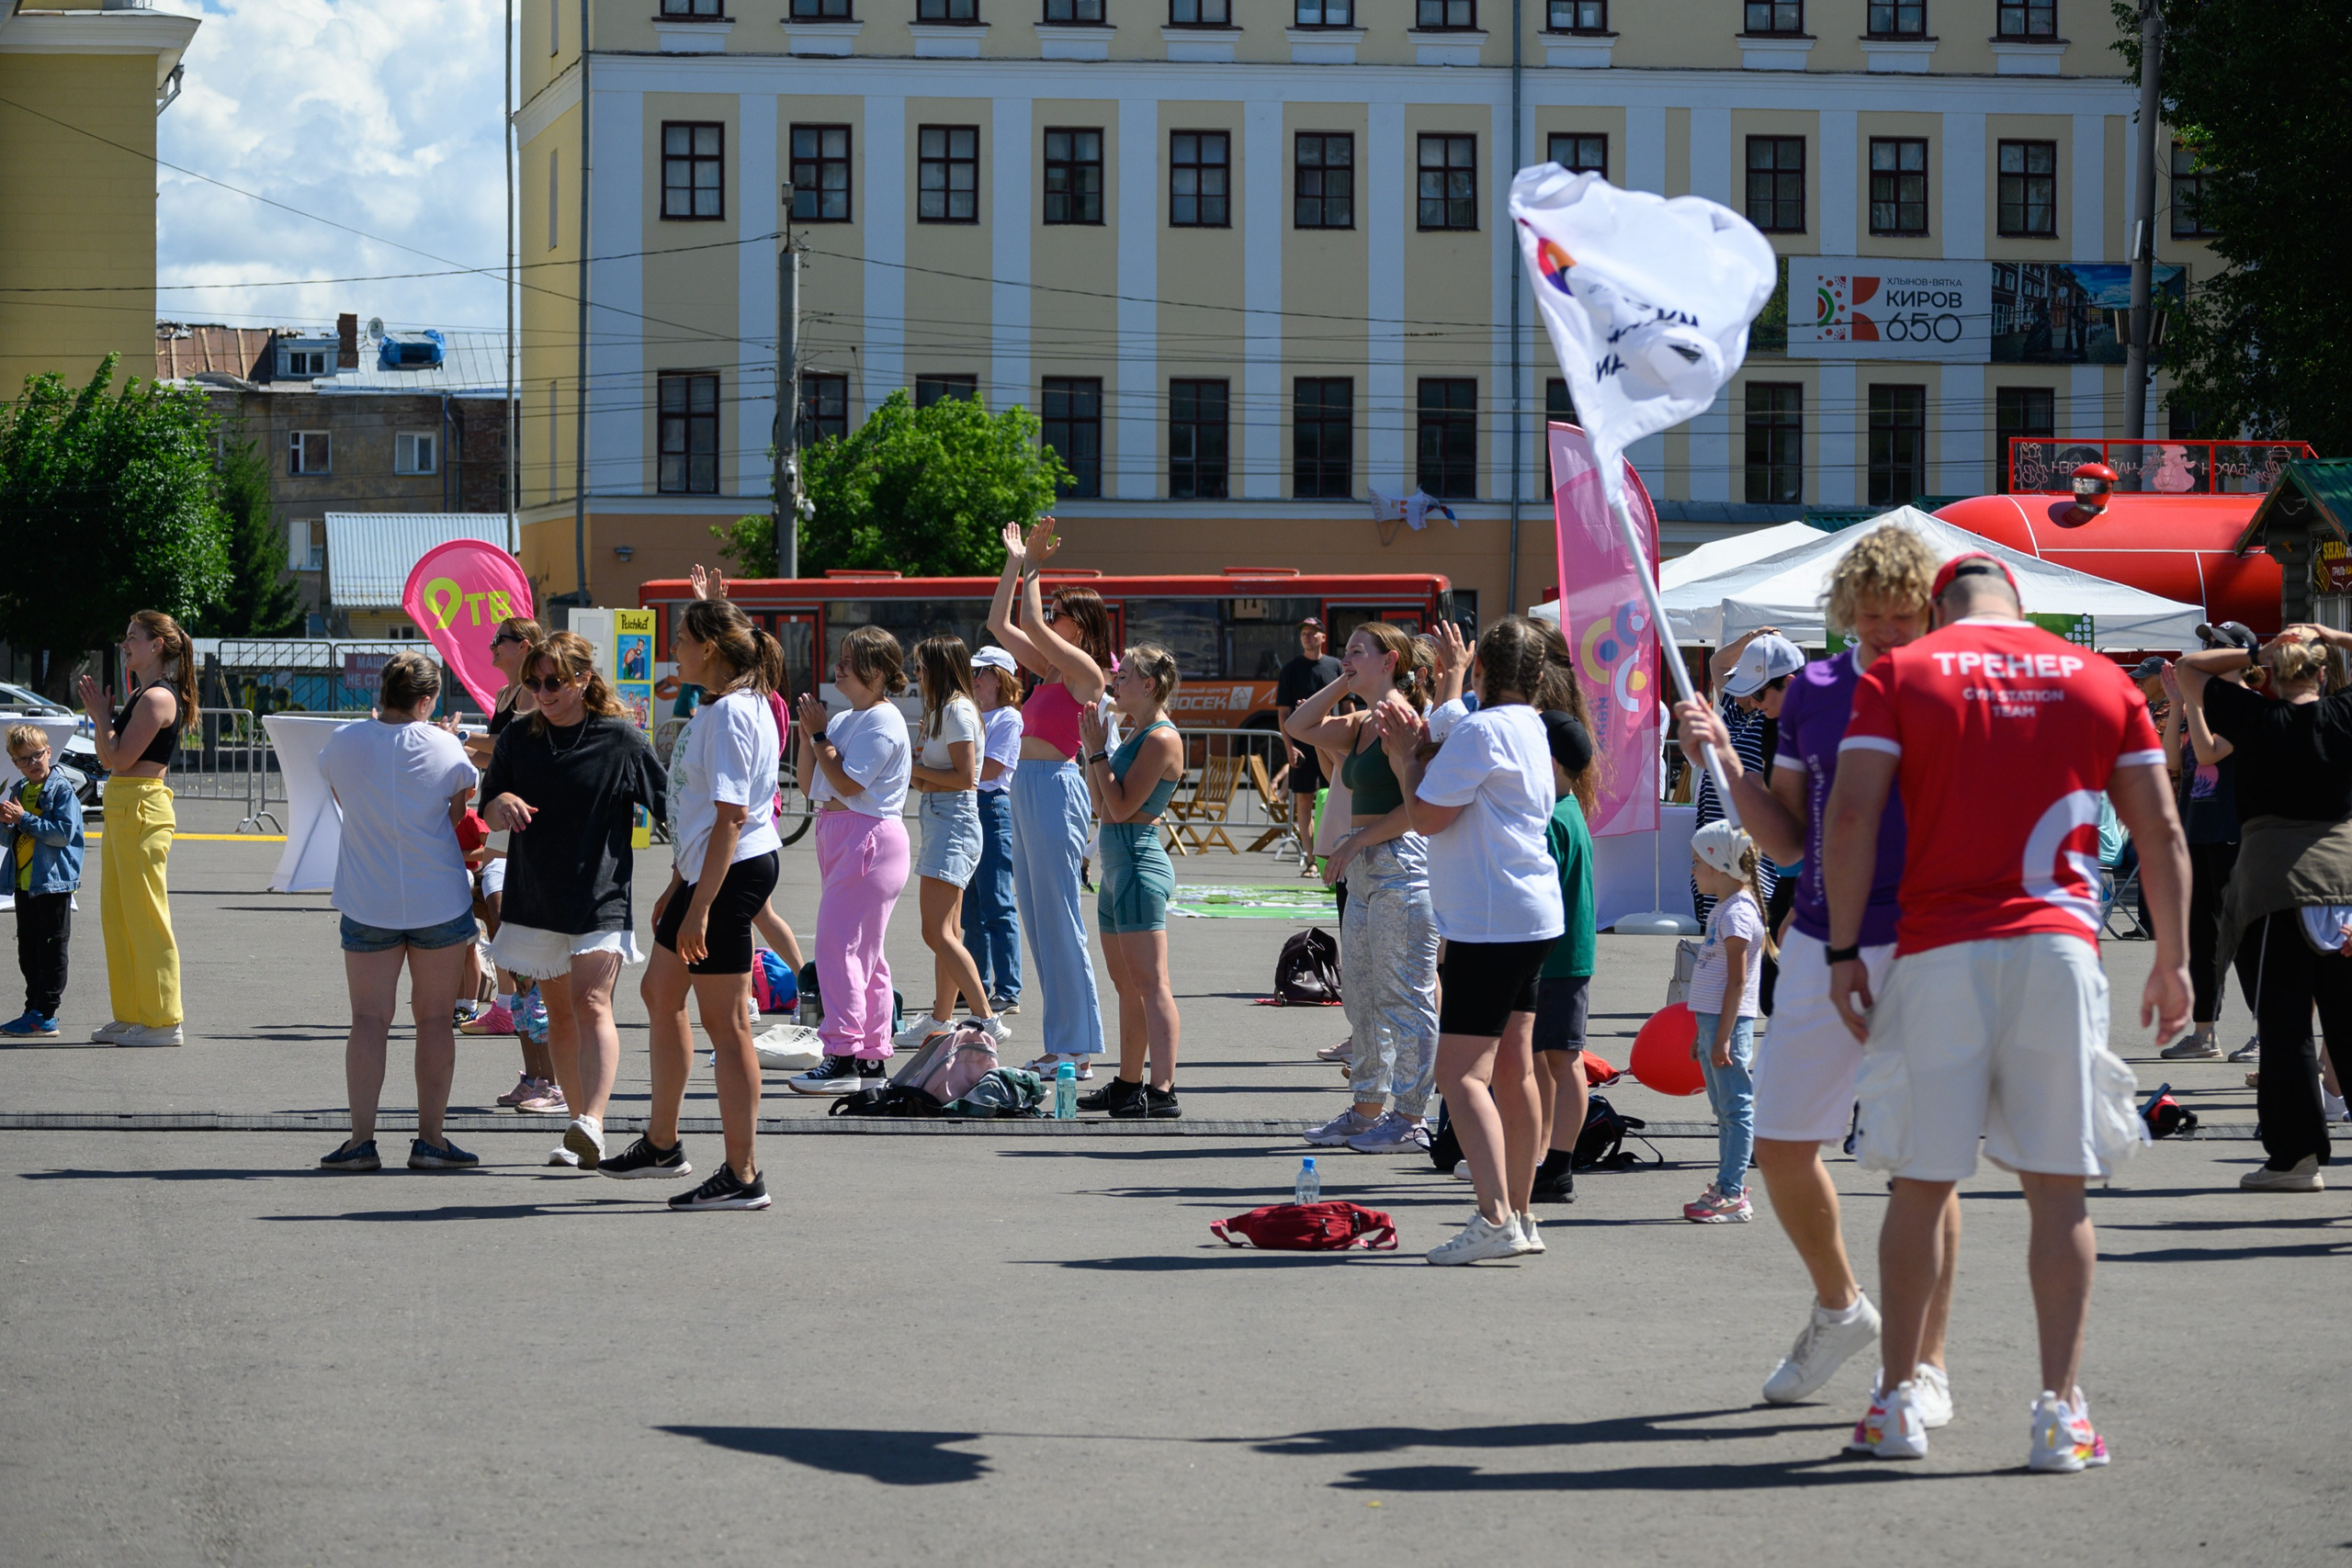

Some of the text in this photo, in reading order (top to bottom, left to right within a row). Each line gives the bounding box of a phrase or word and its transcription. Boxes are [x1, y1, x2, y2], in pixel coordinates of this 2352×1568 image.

[1885, 289, 1963, 309] КИРОВ
[1885, 311, 1963, 344] 650
[1931, 651, 2085, 679] ТРЕНЕР
[346, 673, 362, 687] НЕ
[1991, 705, 2037, 718] TEAM
